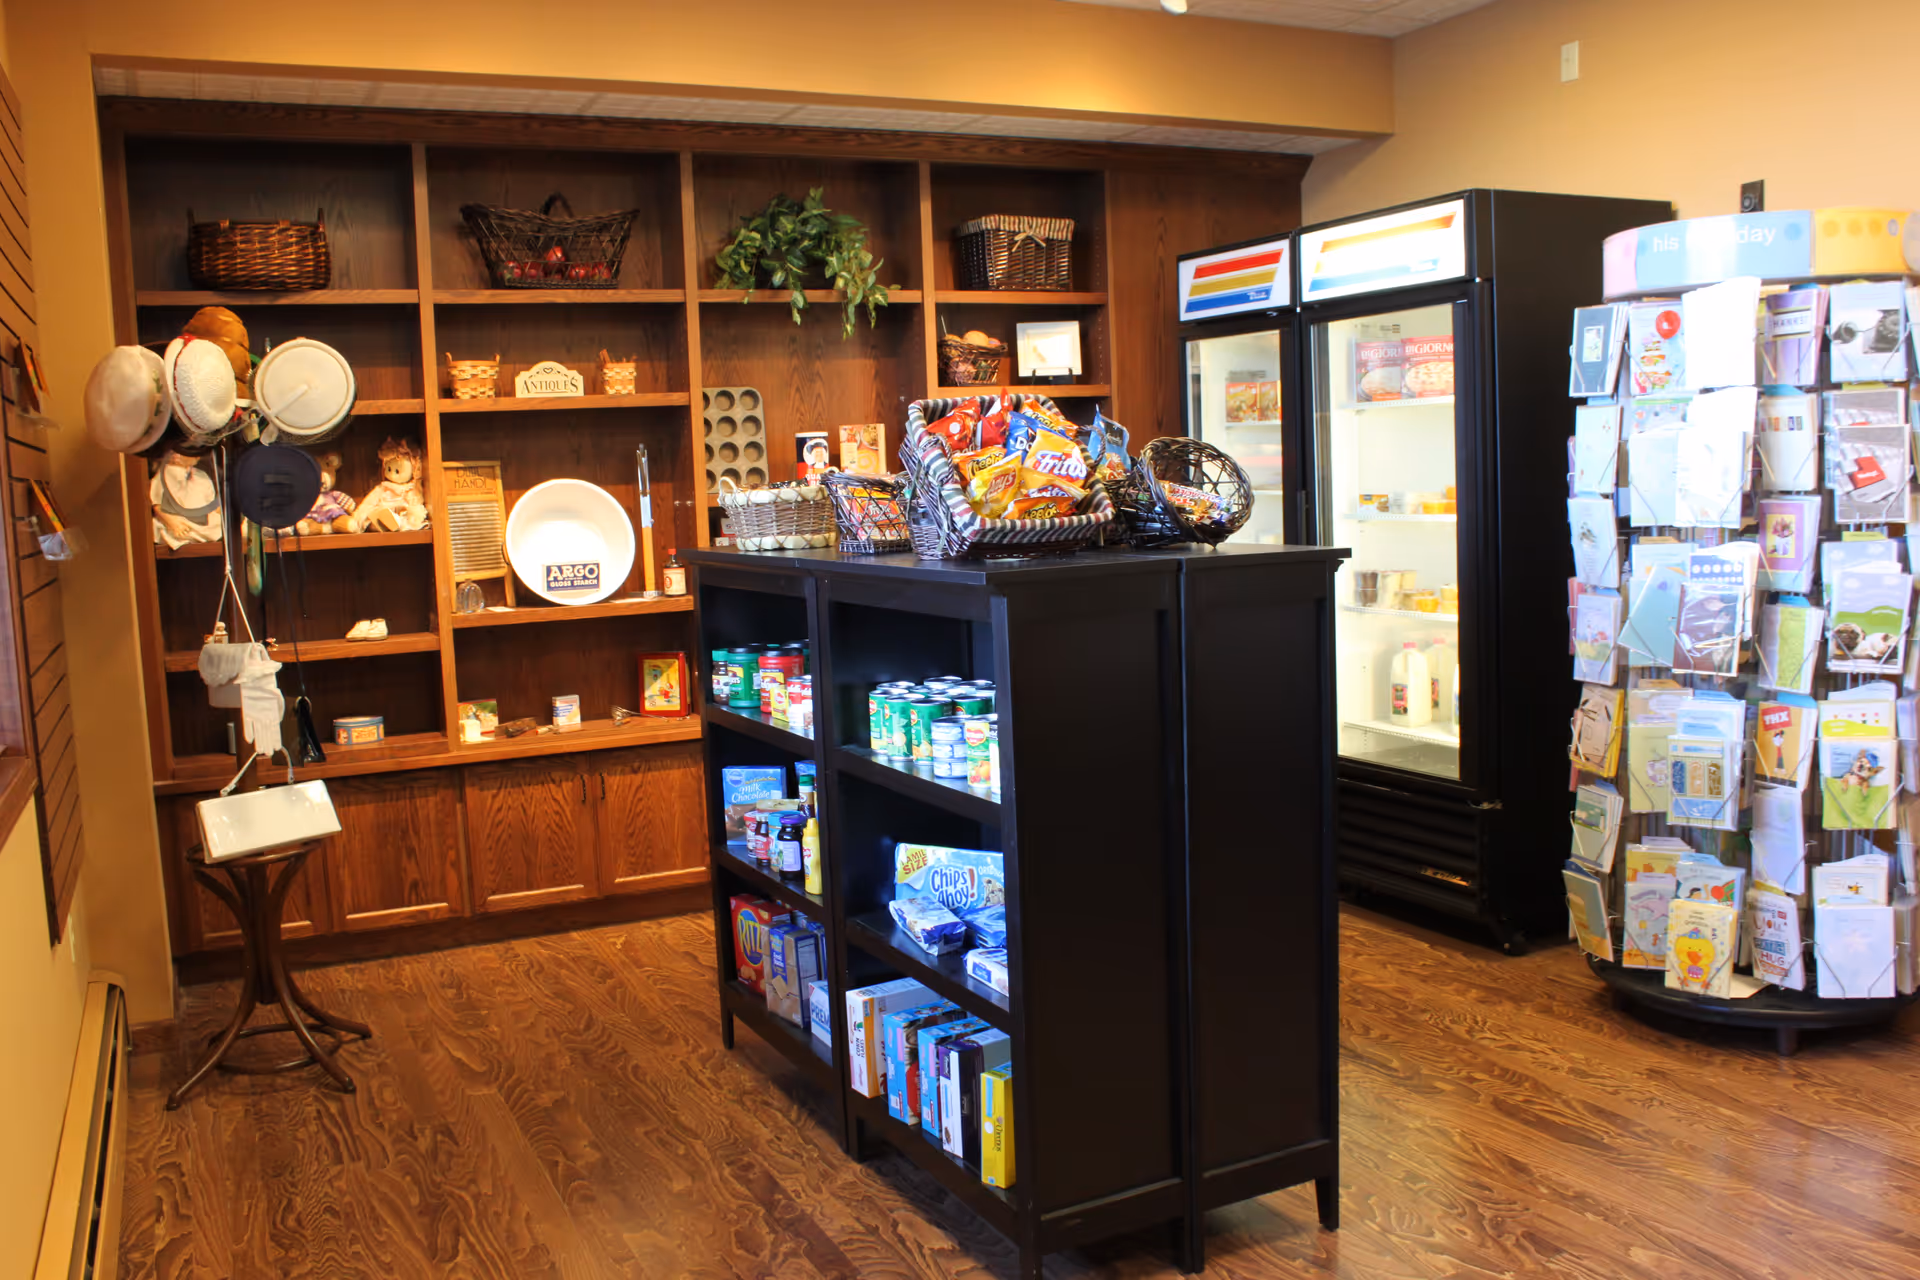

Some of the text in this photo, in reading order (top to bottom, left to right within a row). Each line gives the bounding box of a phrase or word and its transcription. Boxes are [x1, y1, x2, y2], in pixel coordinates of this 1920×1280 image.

[521, 377, 579, 395] ANTIQUES
[1036, 450, 1089, 480] Fritos
[548, 564, 599, 582] ARGO
[550, 580, 572, 588] GLOSS
[573, 578, 598, 586] STARCH
[1763, 711, 1790, 726] THX
[731, 790, 770, 803] Chocolate
[739, 782, 761, 795] Milk
[931, 867, 968, 893] Chips
